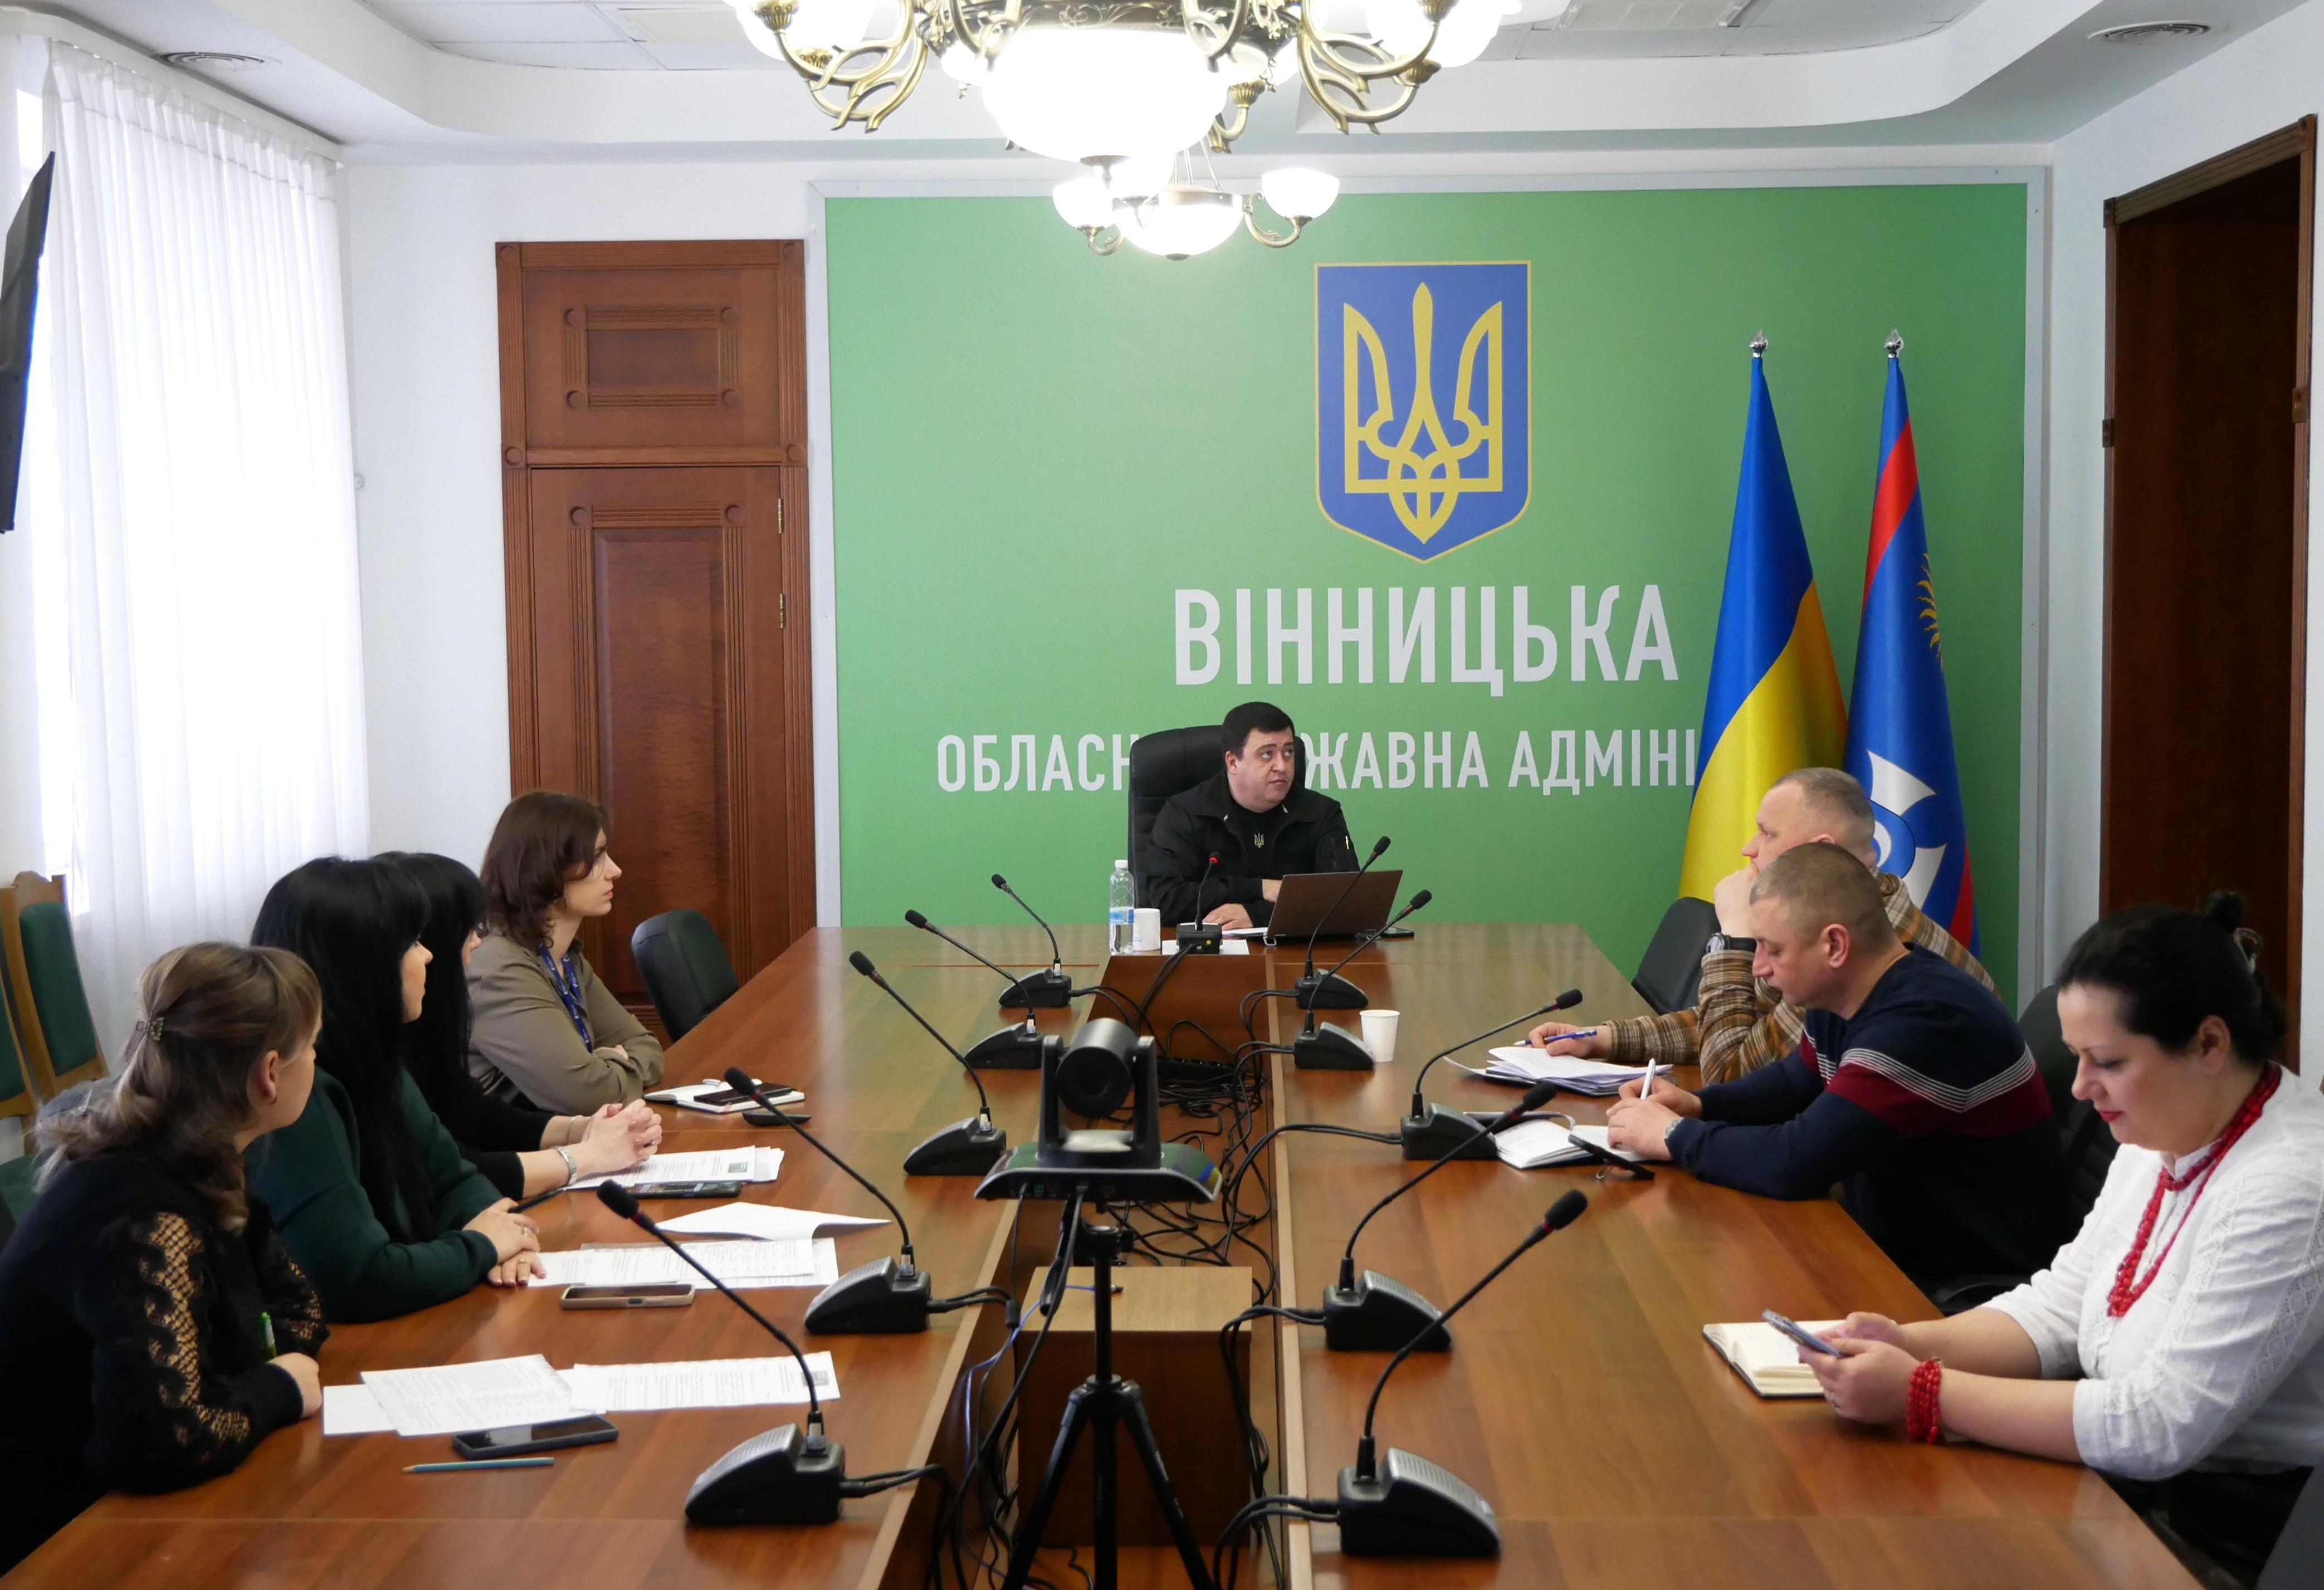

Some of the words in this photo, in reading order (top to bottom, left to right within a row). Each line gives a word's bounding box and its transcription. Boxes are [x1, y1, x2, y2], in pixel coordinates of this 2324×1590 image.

[1173, 584, 1679, 698] ВІННИЦЬКА
[938, 732, 1140, 792] ОБЛАСН
[1301, 730, 1490, 790] ЖАВНА
